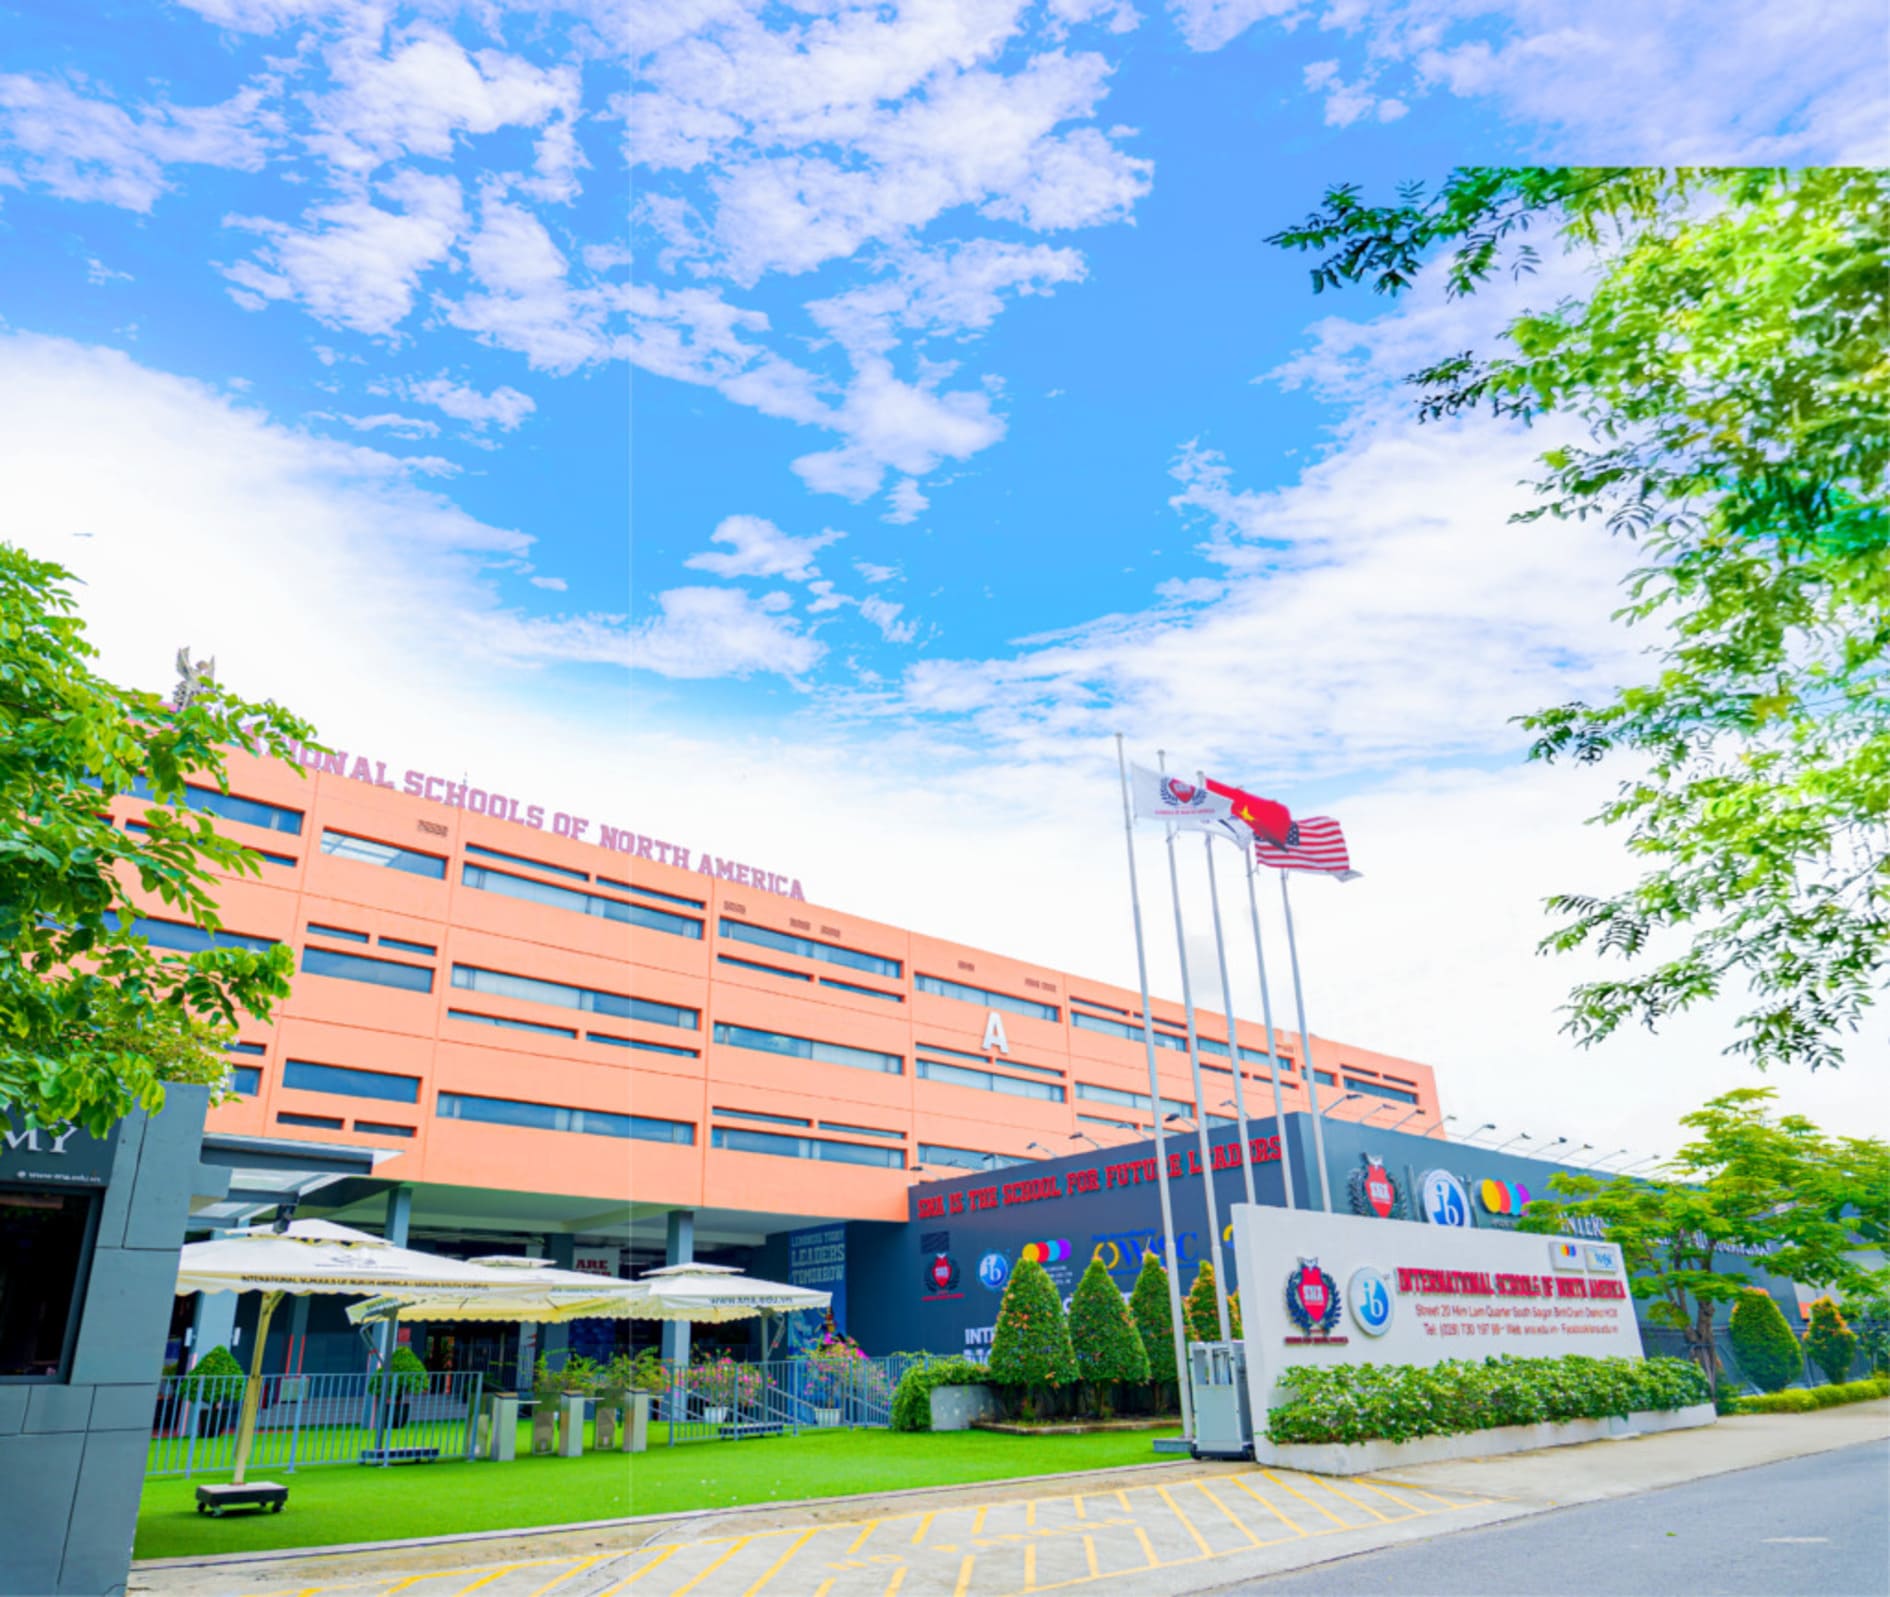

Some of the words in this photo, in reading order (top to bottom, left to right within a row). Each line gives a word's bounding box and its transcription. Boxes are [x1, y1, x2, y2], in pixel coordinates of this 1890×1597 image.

[403, 769, 545, 830] SCHOOLS
[552, 811, 590, 841] OF
[599, 823, 691, 871] NORTH
[698, 853, 806, 902] AMERICA
[982, 1010, 1009, 1053] A
[917, 1195, 945, 1219] SNA
[949, 1192, 967, 1215] IS
[968, 1185, 998, 1212] THE
[1002, 1176, 1061, 1206] SCHOOL
[1066, 1168, 1100, 1196] FOR
